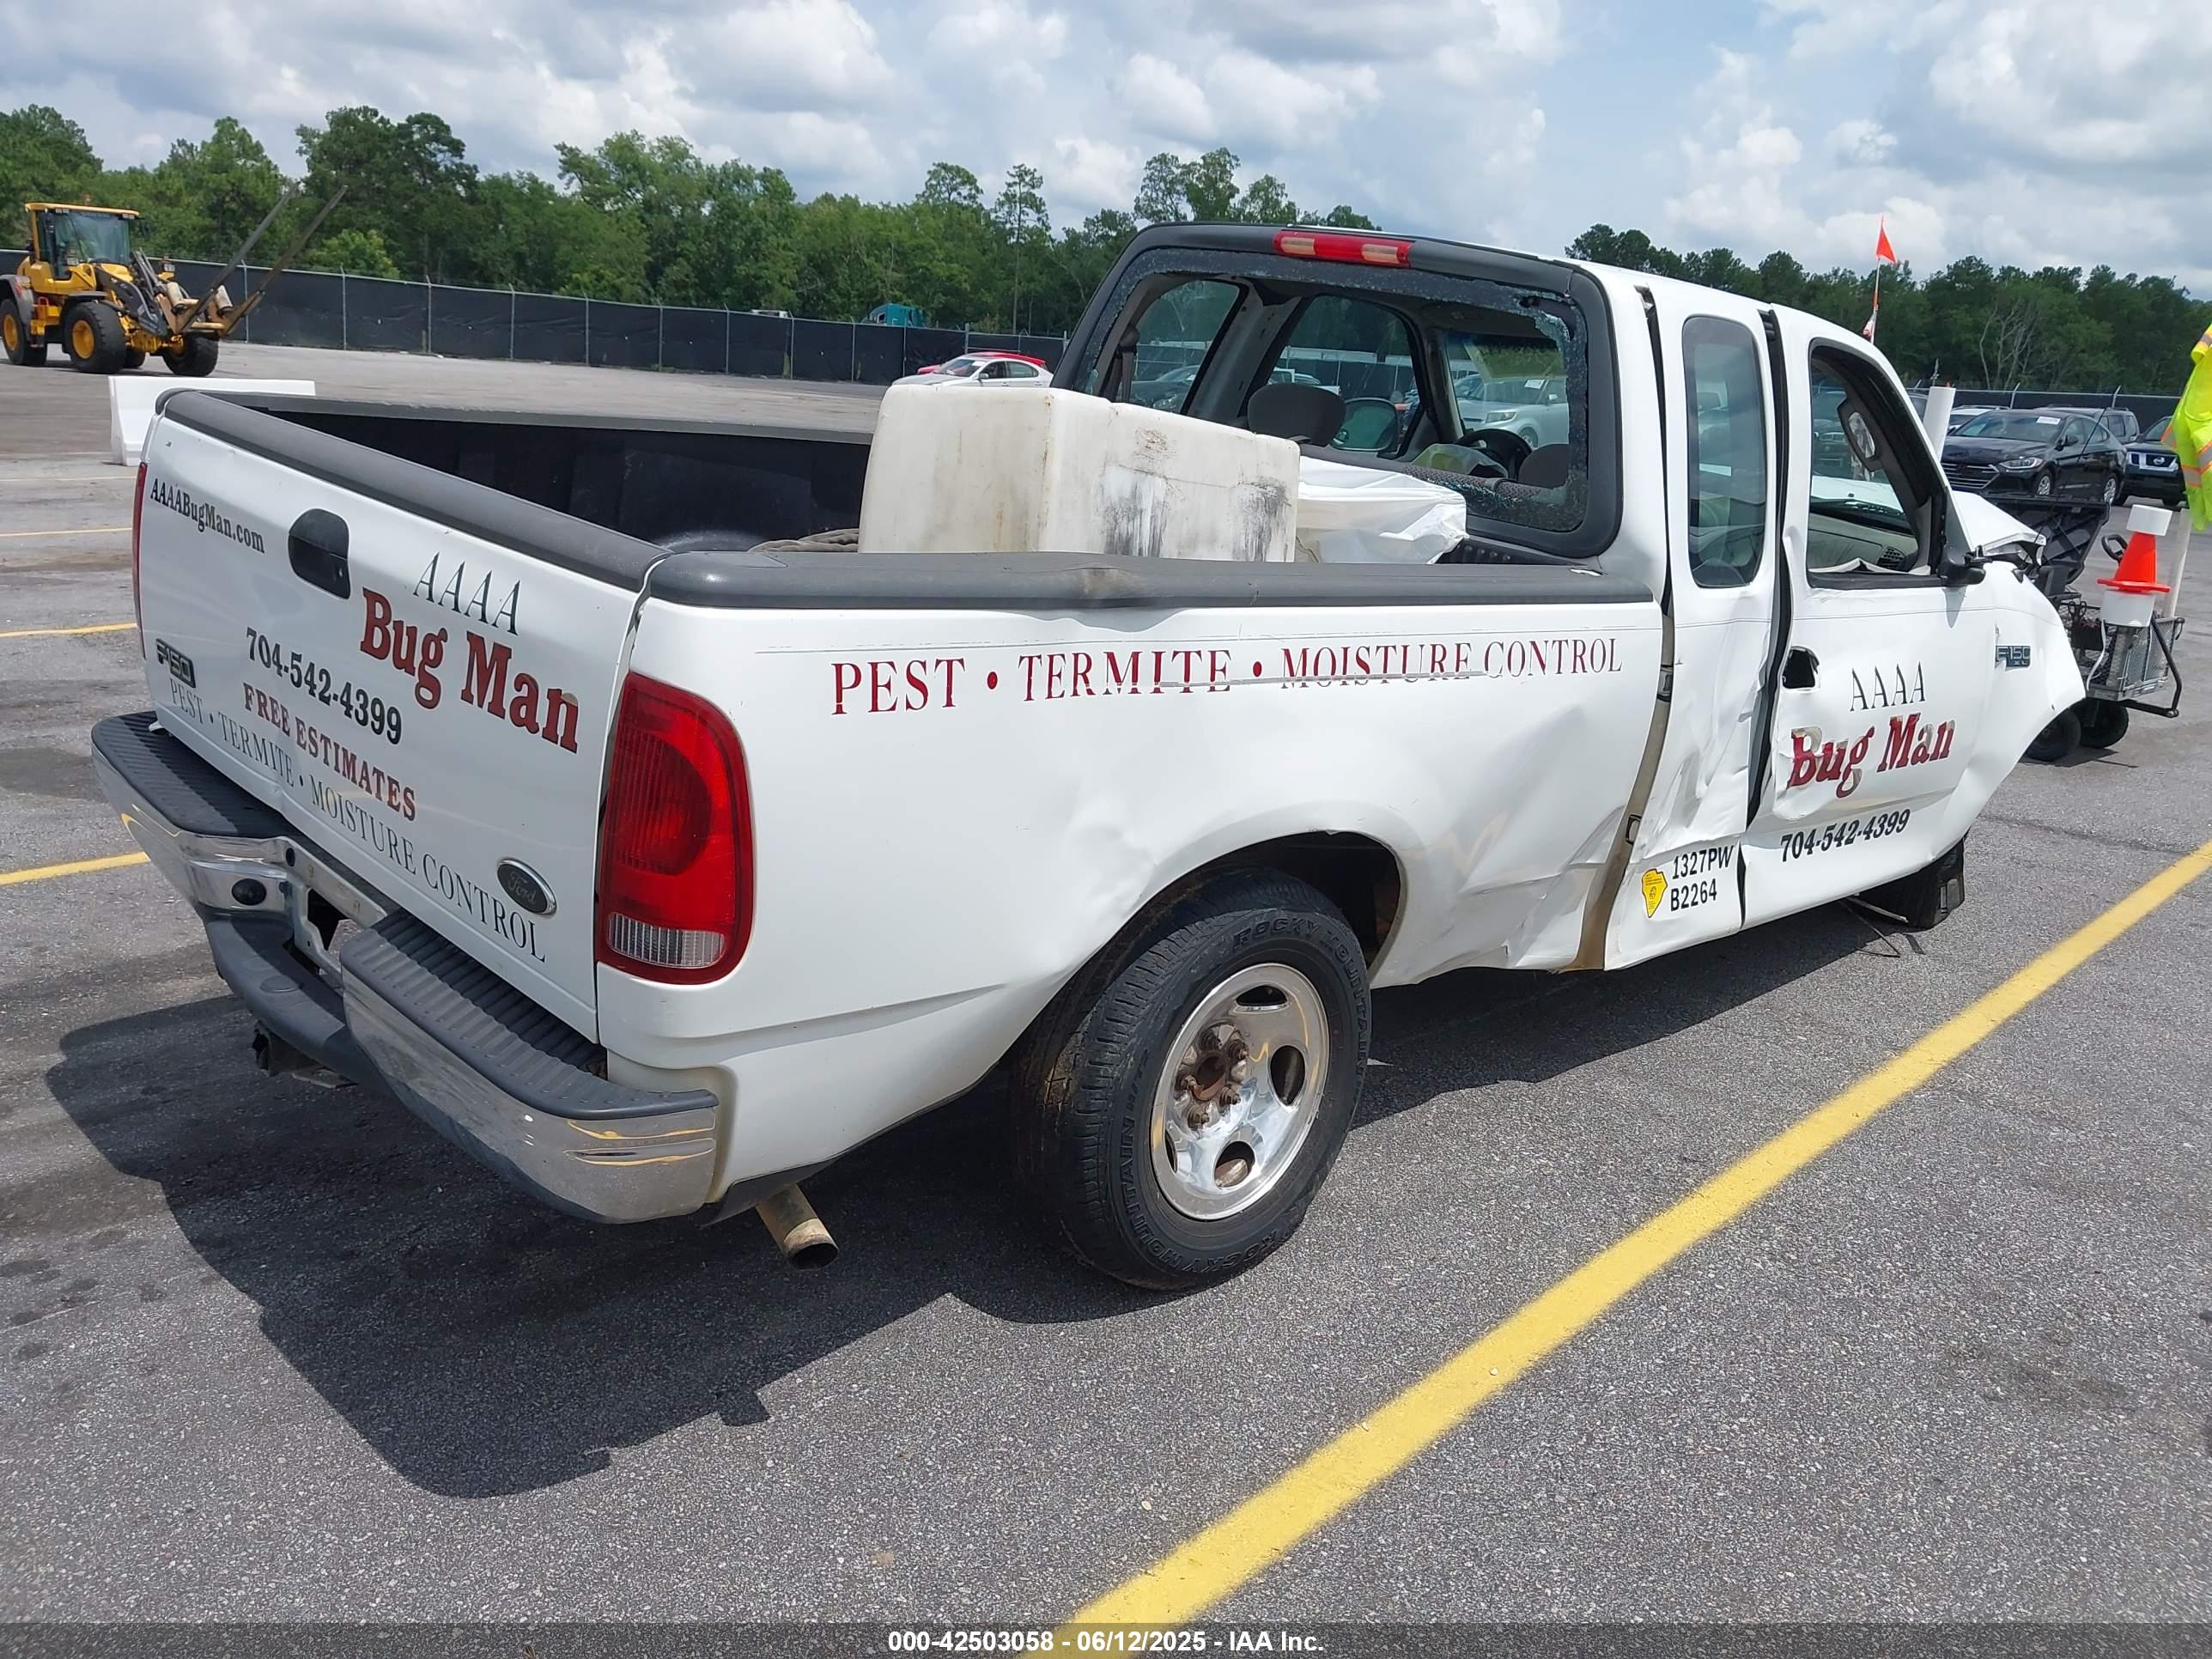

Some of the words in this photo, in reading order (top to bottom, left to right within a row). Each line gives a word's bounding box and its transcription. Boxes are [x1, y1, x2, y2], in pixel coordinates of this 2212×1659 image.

[149, 477, 265, 554] AAAABugMan.com
[413, 551, 520, 635] AAAA
[246, 627, 402, 745] 704-542-4399
[360, 586, 449, 710] Bug
[461, 632, 579, 754] Man
[831, 658, 964, 715] PEST
[1018, 649, 1232, 702] TERMITE
[1280, 641, 1473, 690] MOISTURE
[1483, 638, 1623, 679] CONTROL
[1850, 660, 1926, 712] AAAA
[243, 683, 290, 737] FREE
[295, 716, 416, 822] ESTIMATES
[1786, 726, 1875, 799] Bug
[1876, 713, 1956, 773] Man
[170, 678, 204, 725] PEST
[218, 712, 294, 787] TERMITE
[310, 773, 417, 876] MOISTURE
[423, 852, 547, 963] CONTROL
[1779, 809, 1911, 862] 704-542-4399
[1670, 878, 1717, 912] B2264
[1672, 845, 1735, 880] 1327PW
[1232, 917, 1321, 946] ROCKY
